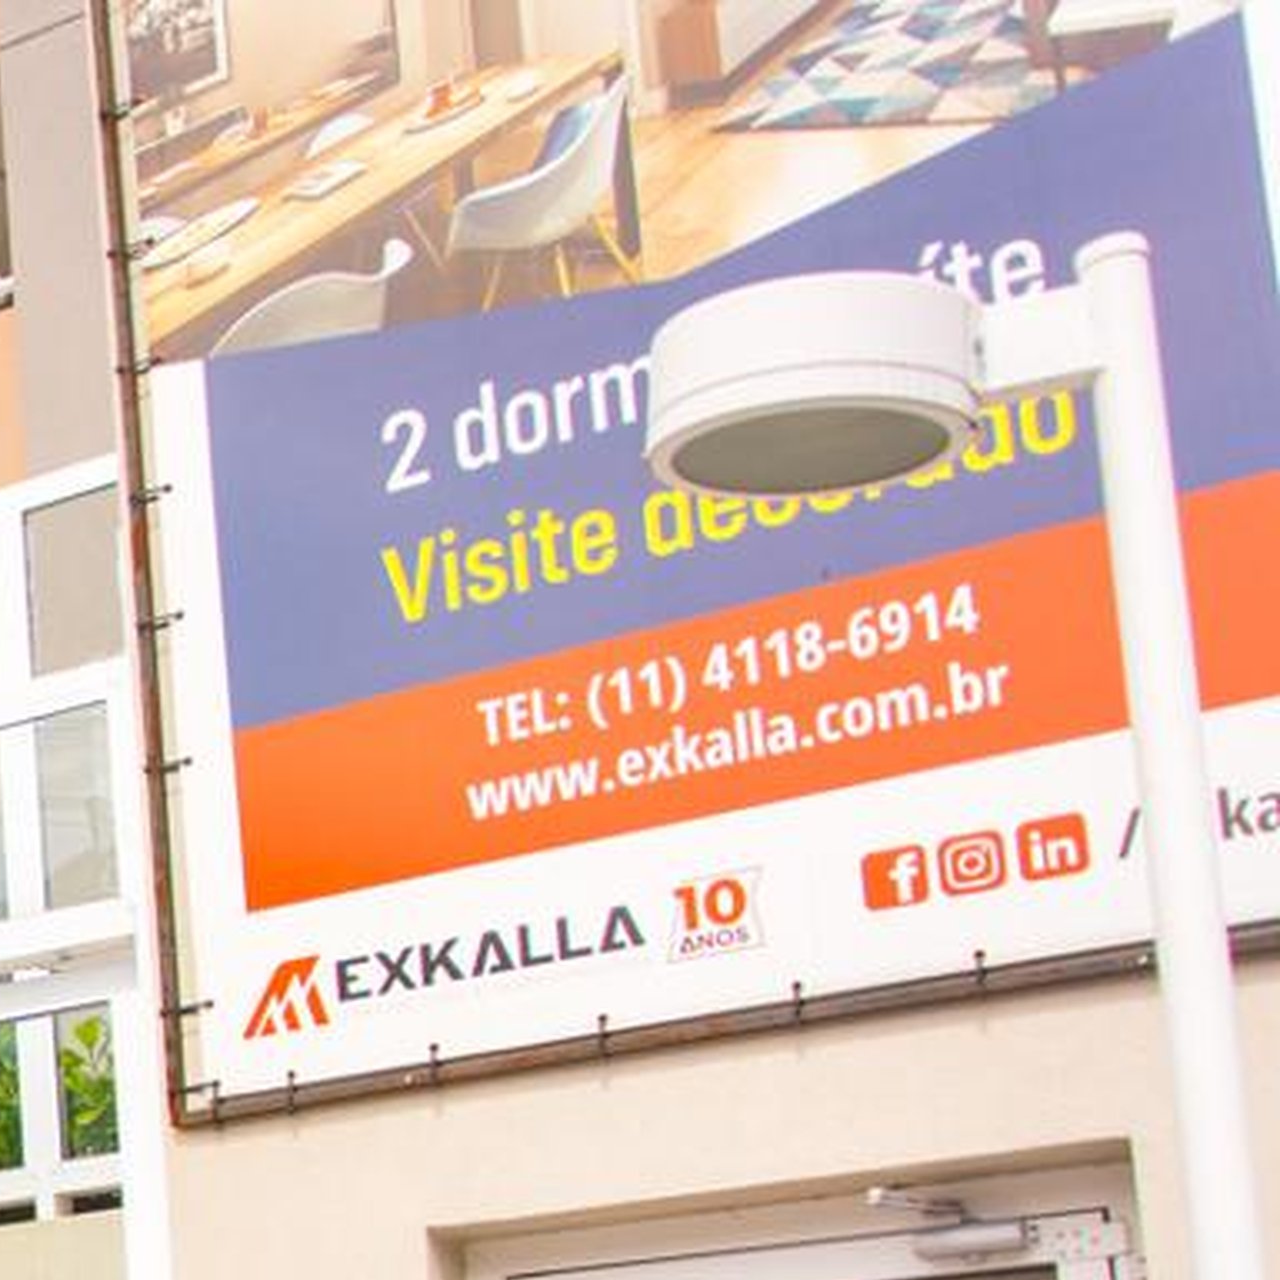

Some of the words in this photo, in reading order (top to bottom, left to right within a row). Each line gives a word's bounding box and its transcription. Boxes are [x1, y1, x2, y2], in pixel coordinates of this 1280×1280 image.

[381, 408, 431, 492] 2
[454, 353, 651, 471] dorm
[381, 502, 618, 624] Visite
[476, 689, 572, 746] TEL:
[586, 654, 686, 729] (11)
[701, 583, 979, 693] 4118-6914
[465, 660, 1010, 820] www.exkalla.com.br
[335, 905, 646, 1003] EXKALLA
[672, 878, 747, 931] 10
[679, 925, 751, 955] ANOS
